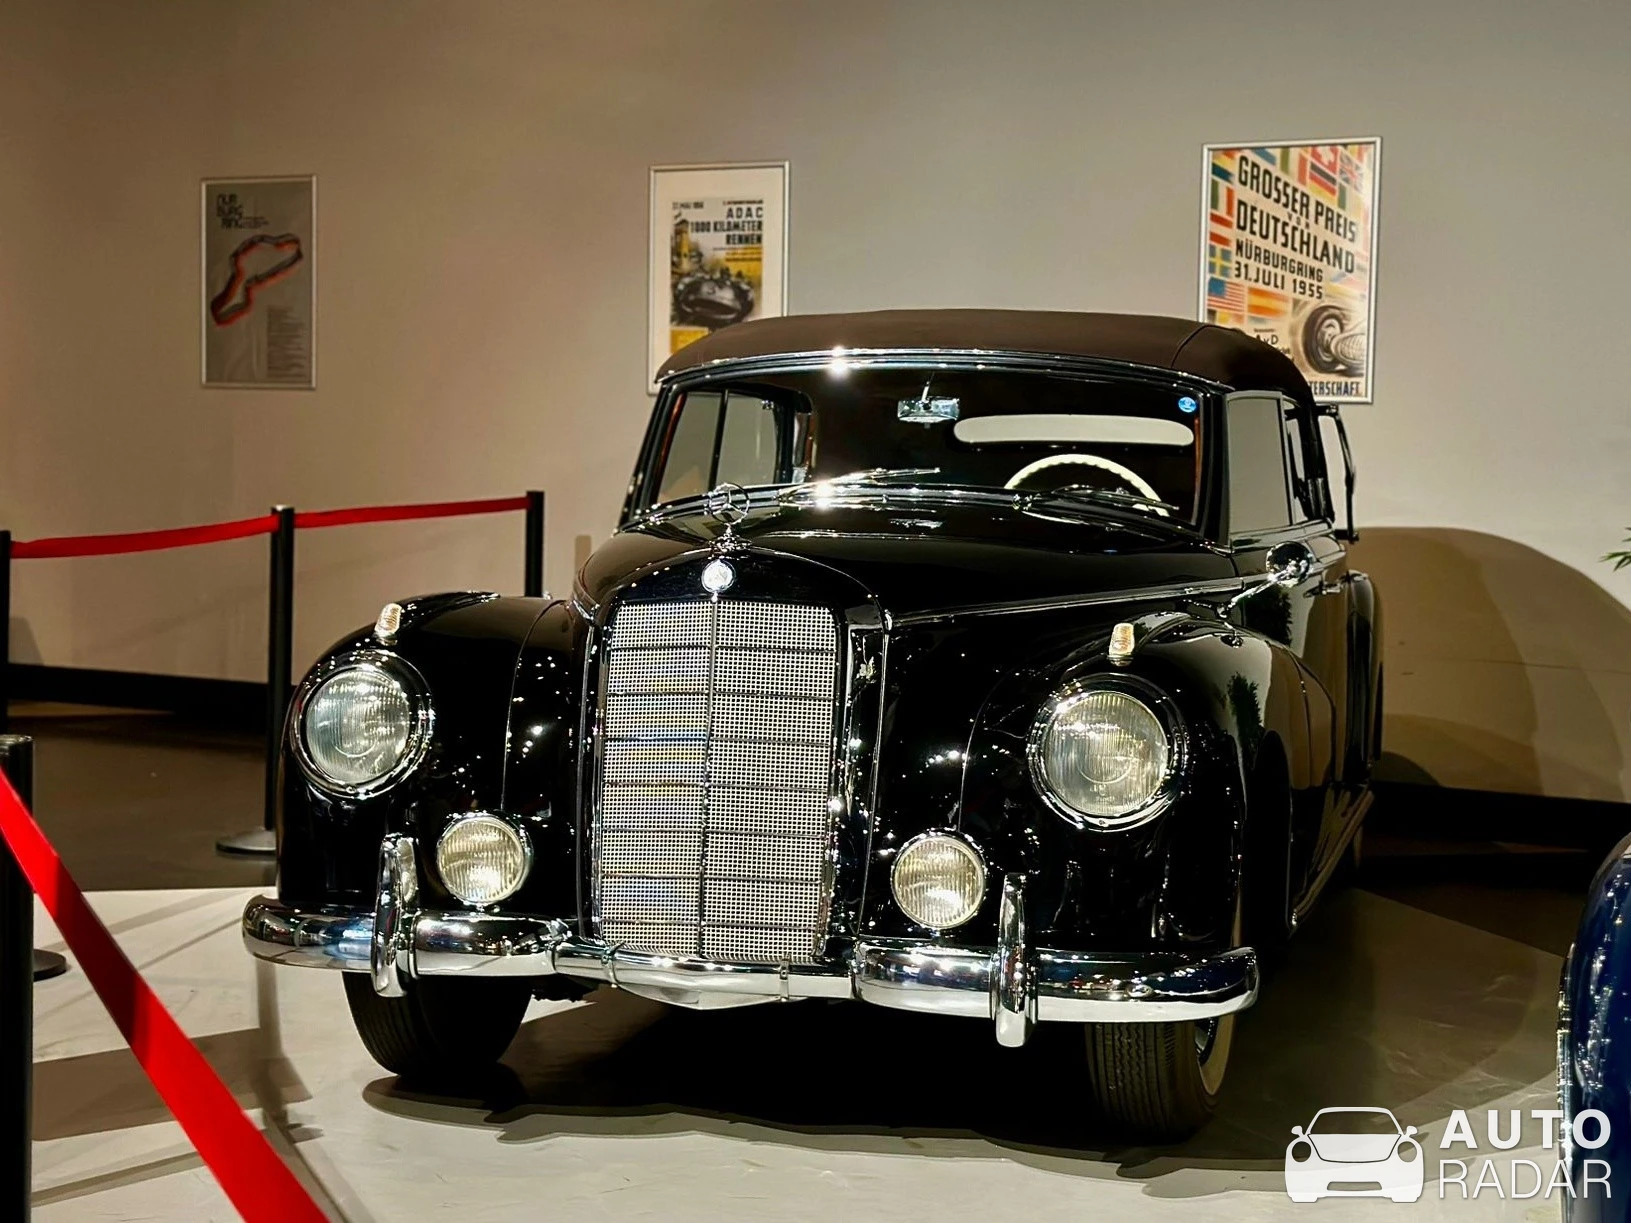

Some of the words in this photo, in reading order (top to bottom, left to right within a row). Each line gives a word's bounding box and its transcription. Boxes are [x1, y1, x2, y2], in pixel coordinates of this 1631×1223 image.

[726, 207, 763, 219] ADAC
[1238, 155, 1310, 220] GROSSER
[1315, 200, 1356, 243] PREIS
[1237, 198, 1355, 273] DEUTSCHLAND
[1235, 238, 1323, 282] NÜRBURGRING
[1292, 278, 1323, 299] 1955
